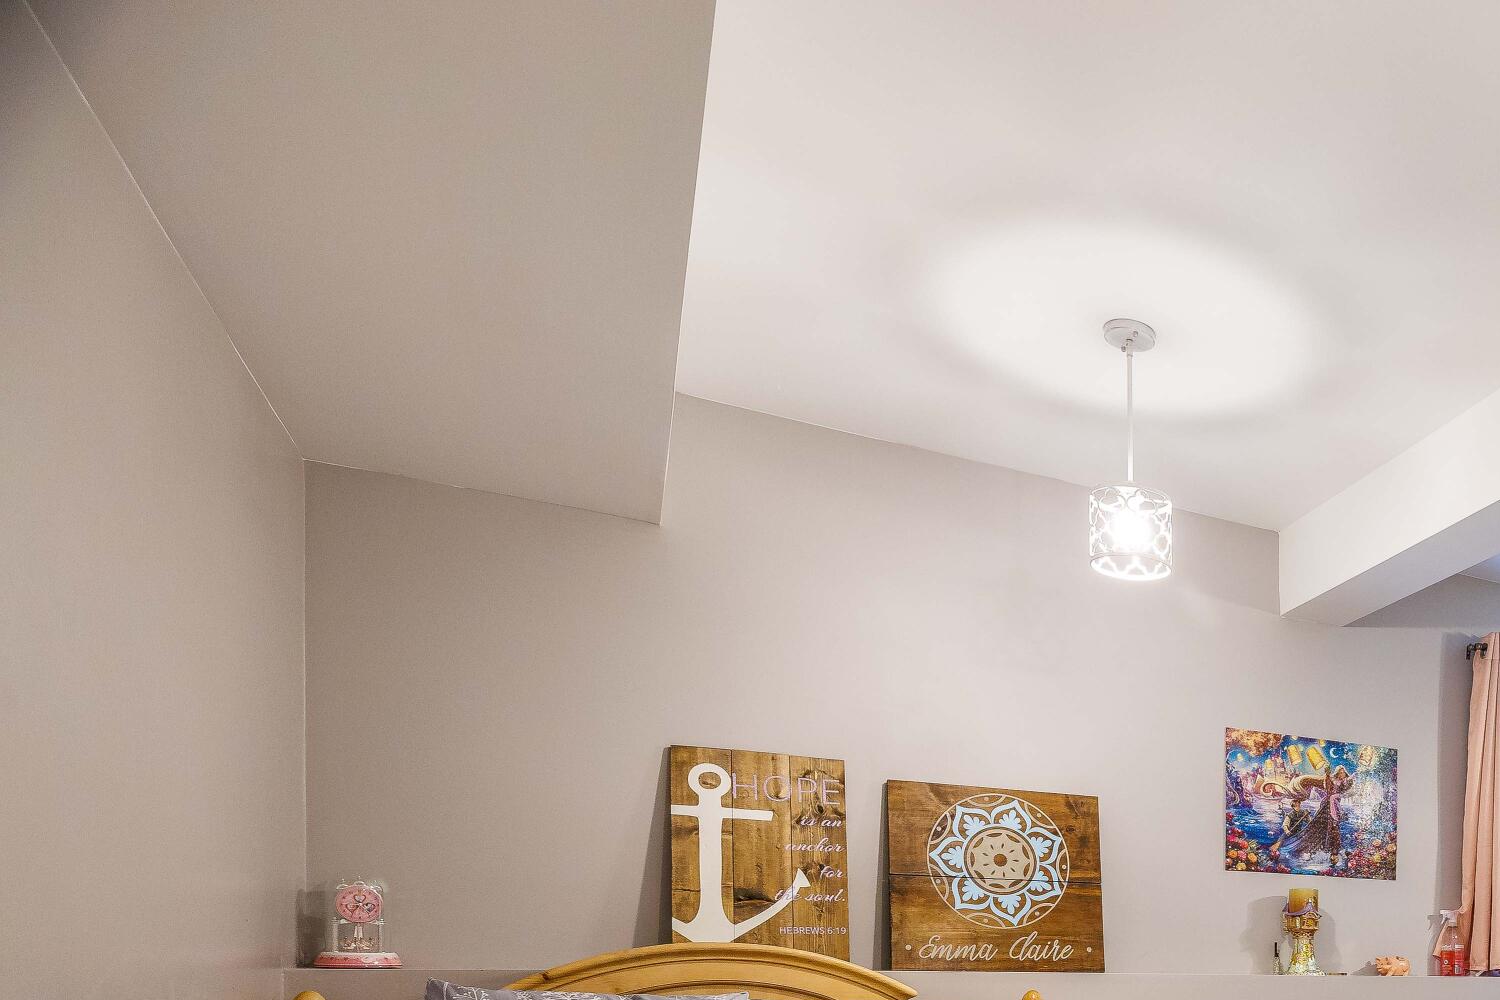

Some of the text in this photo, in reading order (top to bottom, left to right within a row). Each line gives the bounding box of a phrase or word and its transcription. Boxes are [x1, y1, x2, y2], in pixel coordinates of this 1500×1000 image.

[732, 773, 840, 805] HOPE
[800, 816, 842, 828] is an
[784, 837, 845, 852] anchor
[819, 865, 843, 879] for
[774, 888, 846, 902] the soul.
[779, 926, 847, 935] HEBREWS 6:19
[918, 930, 1074, 961] Emma Claire
